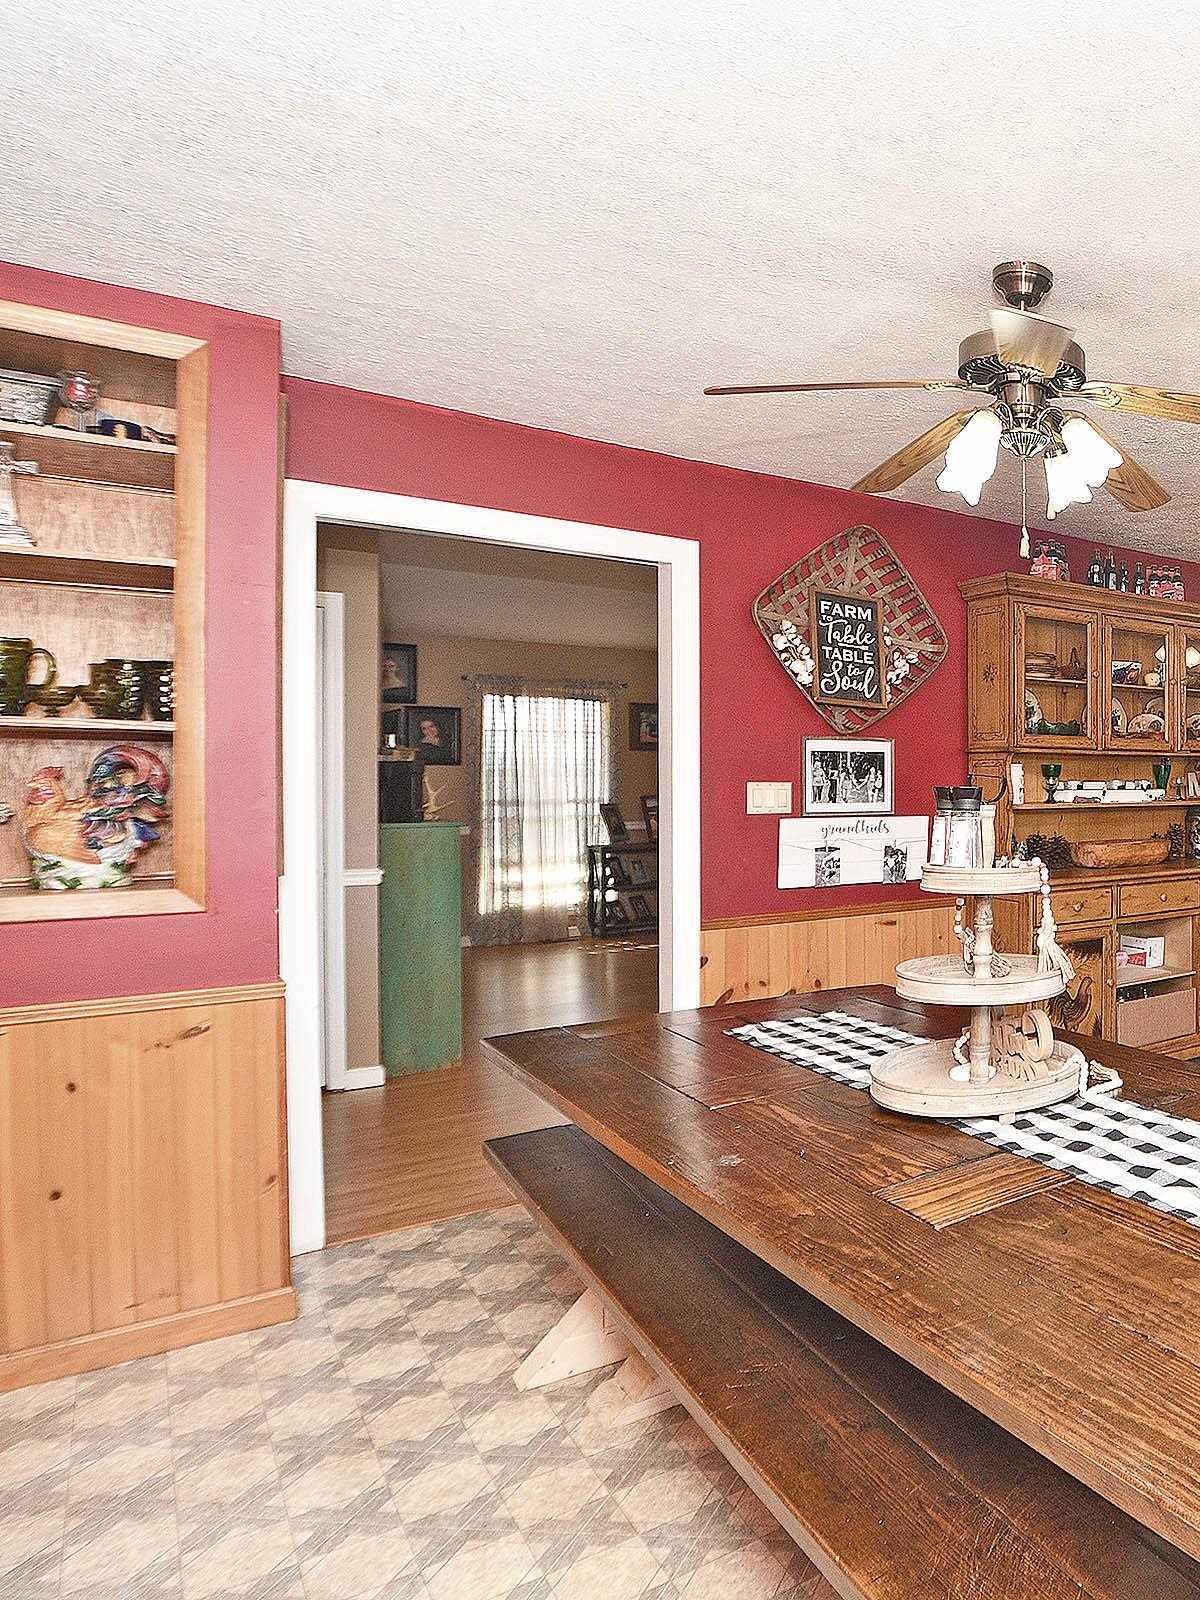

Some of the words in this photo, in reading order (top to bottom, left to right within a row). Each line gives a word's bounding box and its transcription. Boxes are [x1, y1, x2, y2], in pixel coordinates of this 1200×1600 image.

[820, 600, 872, 622] FARM
[819, 618, 876, 646] Table
[821, 646, 874, 665] TABLE
[821, 661, 878, 699] Soul
[847, 663, 865, 677] to
[820, 820, 890, 838] grandkids
